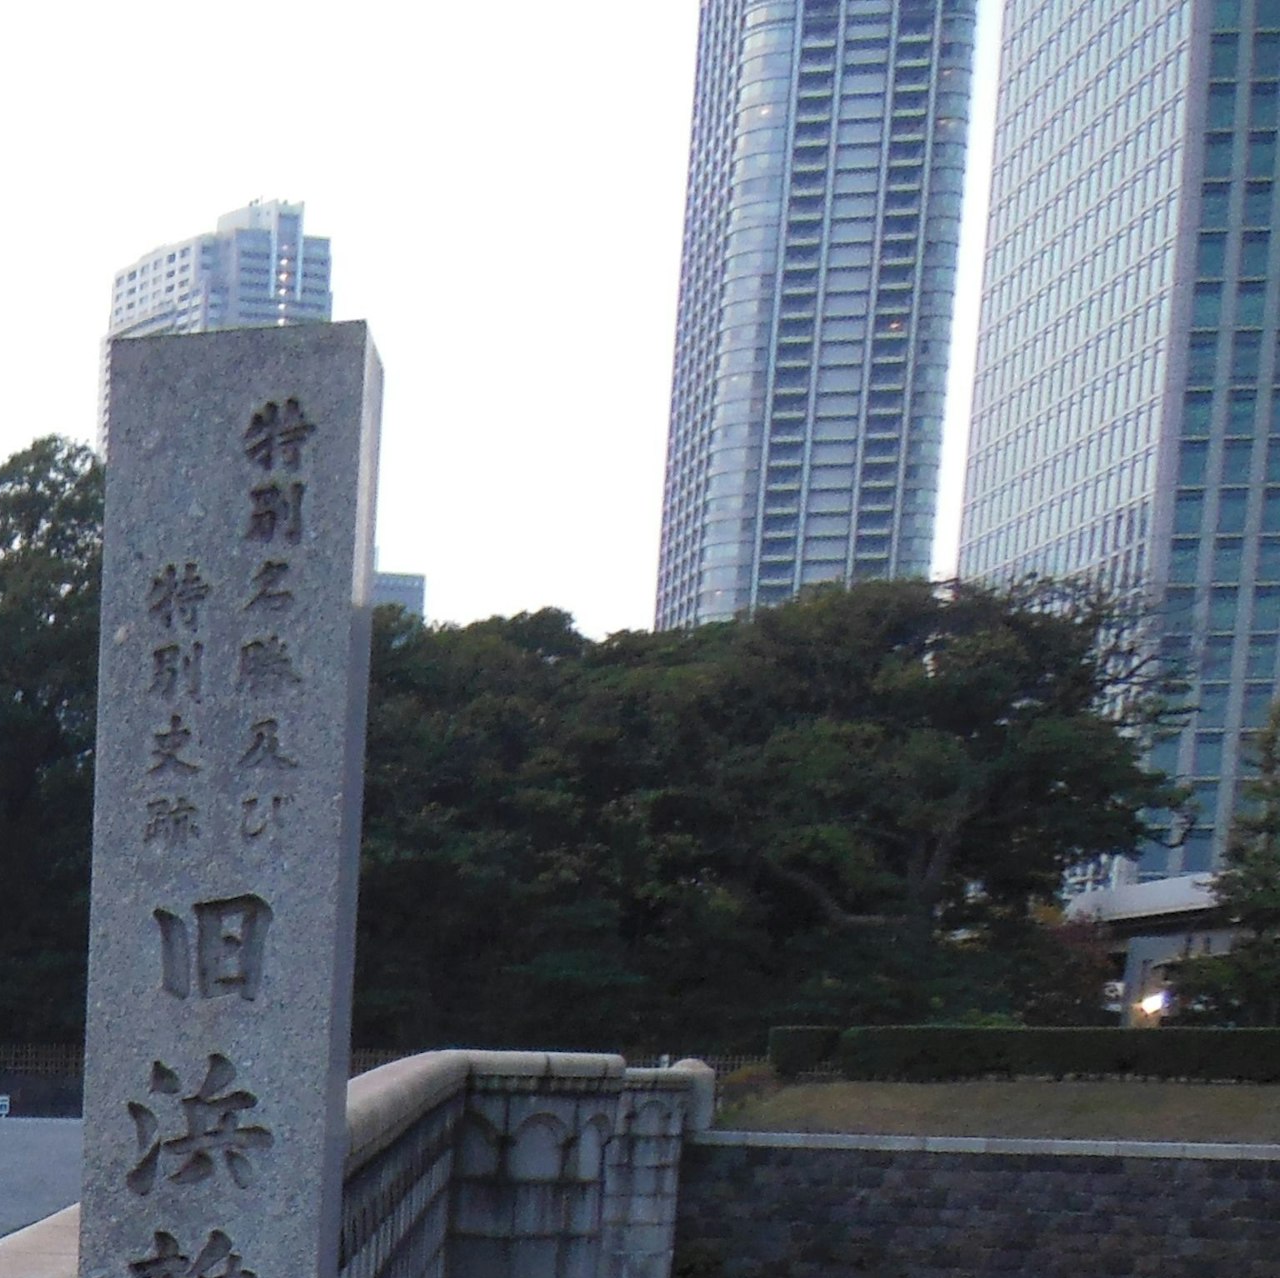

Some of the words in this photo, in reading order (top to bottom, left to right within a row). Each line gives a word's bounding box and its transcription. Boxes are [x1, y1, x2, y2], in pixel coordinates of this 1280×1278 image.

[142, 561, 211, 846] 特別史跡
[239, 396, 317, 839] 特別名勝及び
